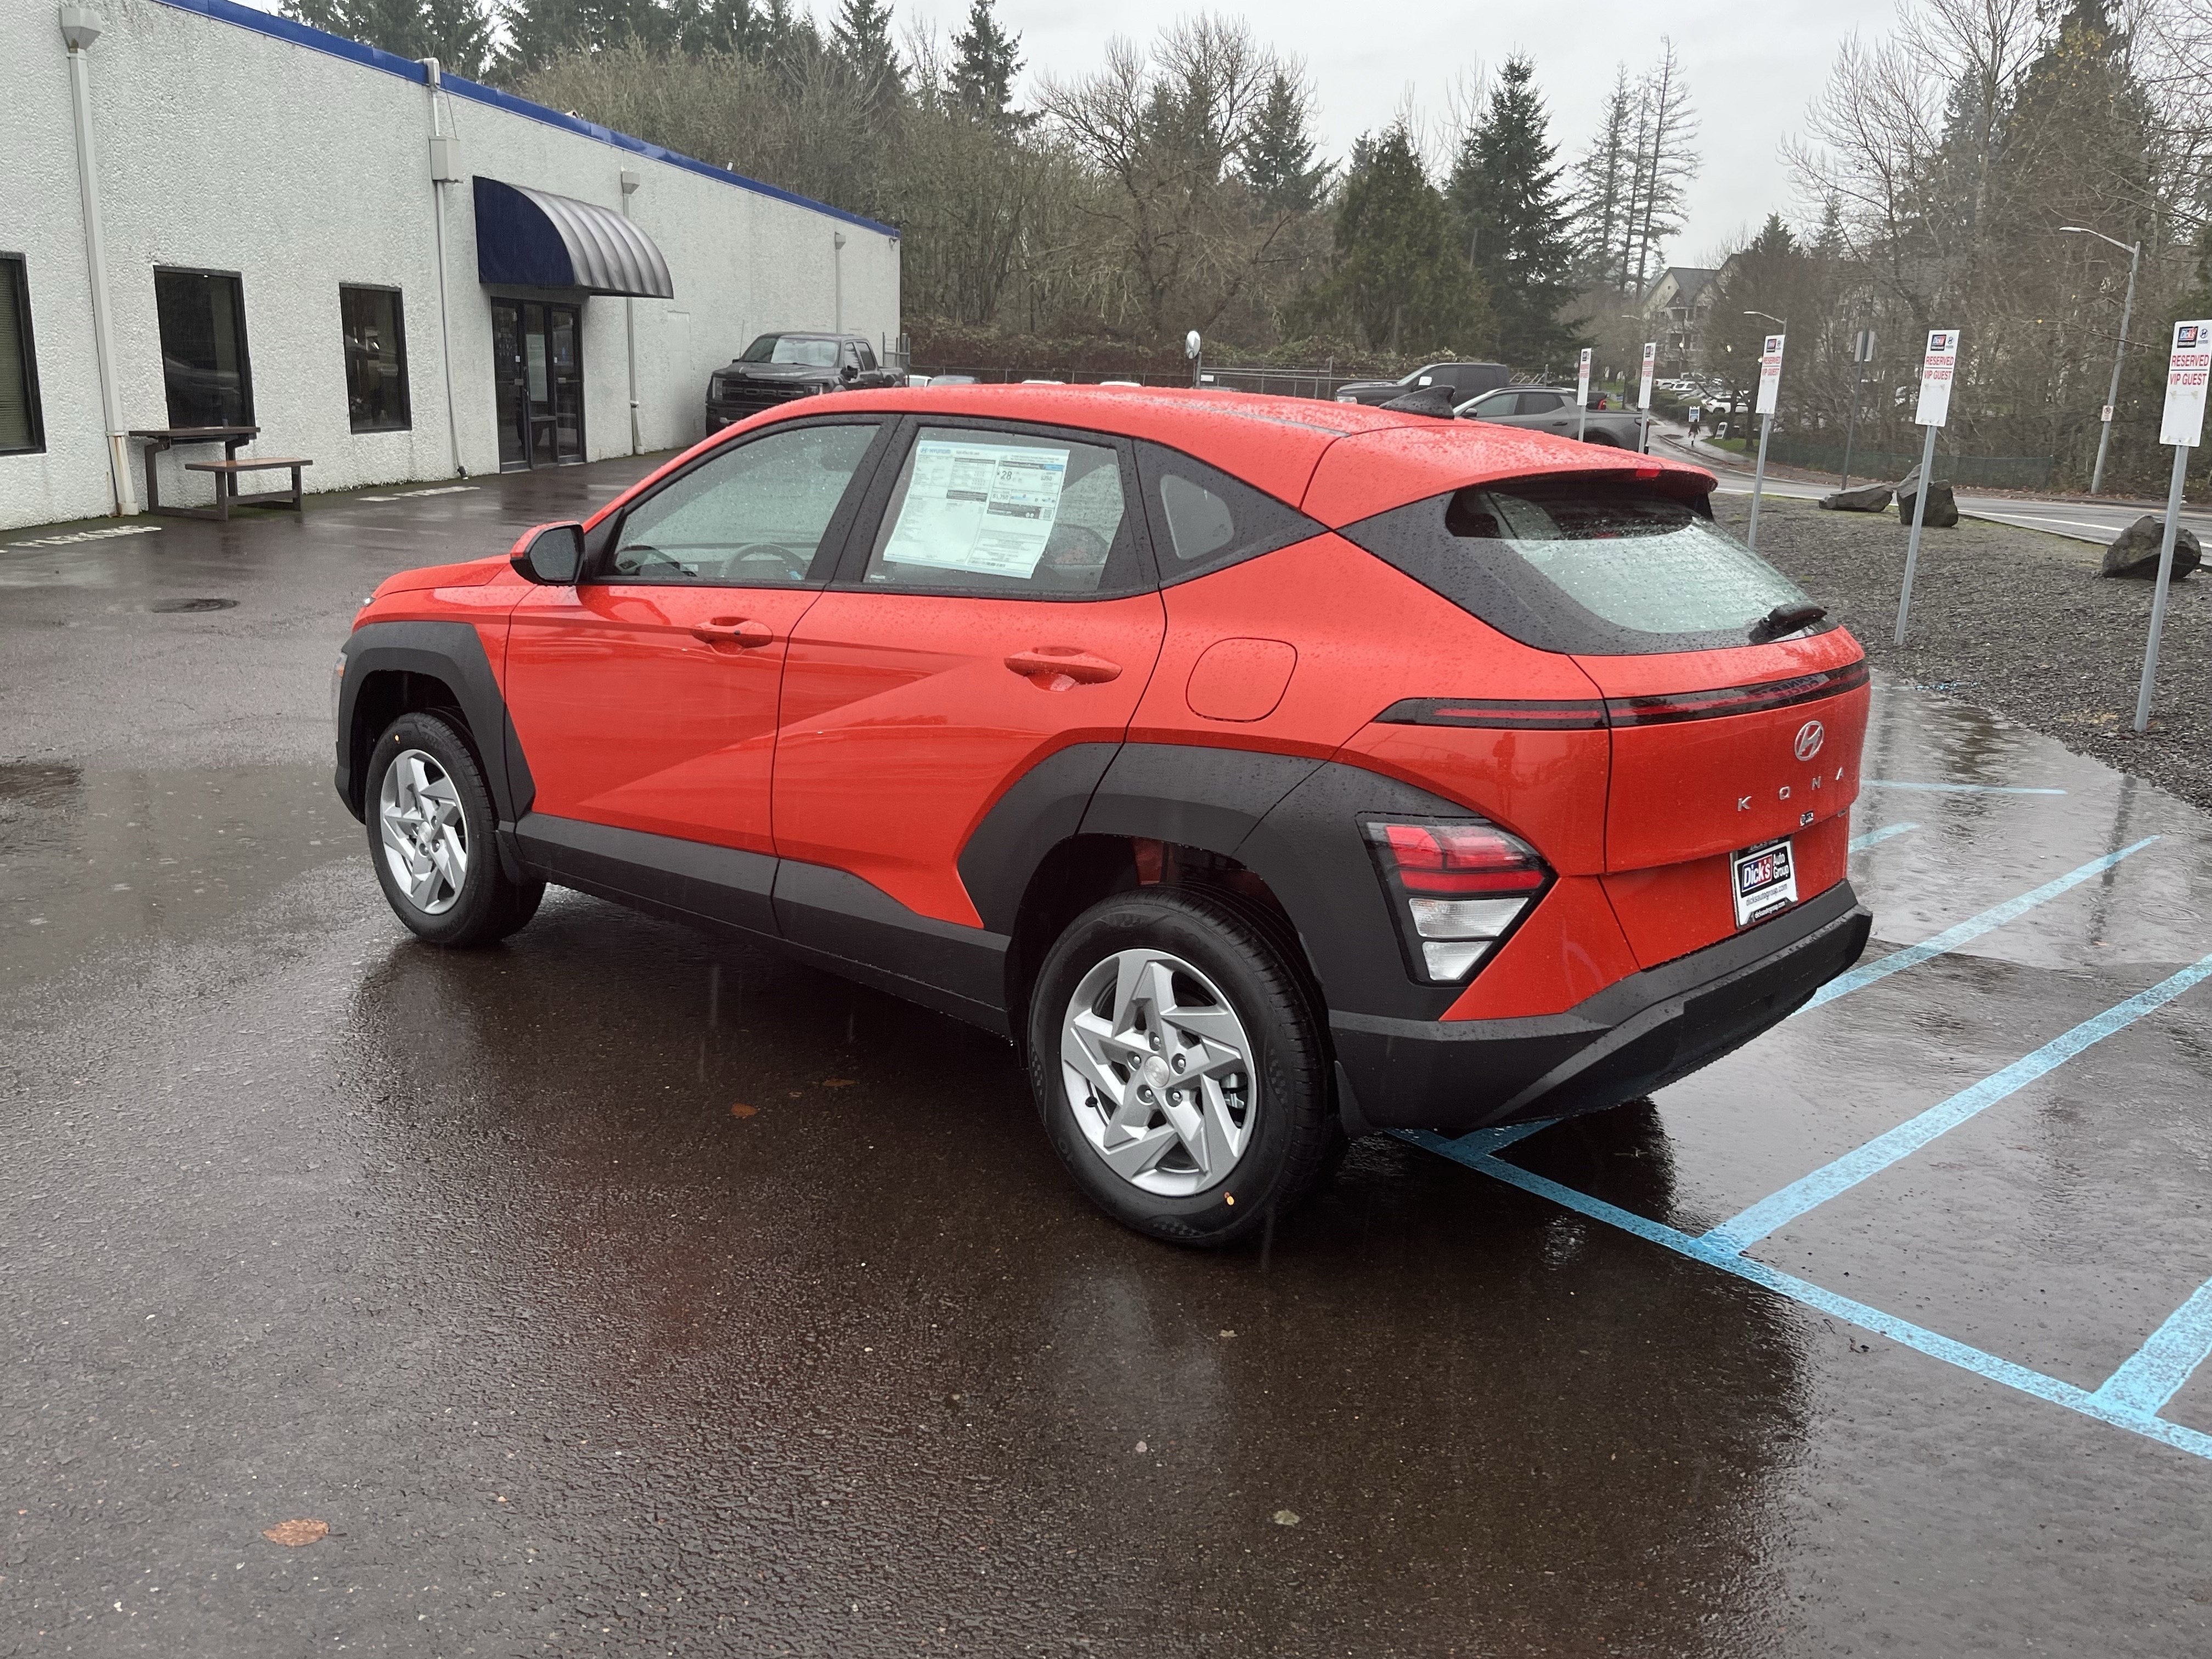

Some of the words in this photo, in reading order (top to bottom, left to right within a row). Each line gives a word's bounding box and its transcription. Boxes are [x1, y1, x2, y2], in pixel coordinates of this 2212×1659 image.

[1926, 357, 1954, 366] RESERVED
[2171, 355, 2209, 367] RESERVED
[1925, 370, 1933, 379] VIP
[1933, 371, 1953, 380] GUEST
[2170, 374, 2181, 385] VIP
[2182, 374, 2207, 386] GUEST
[729, 387, 794, 397] FORD
[1001, 470, 1012, 480] 28
[1737, 766, 1844, 811] KONA
[1773, 852, 1786, 866] Auto
[1743, 859, 1771, 888] Dick's
[1773, 865, 1789, 879] Group
